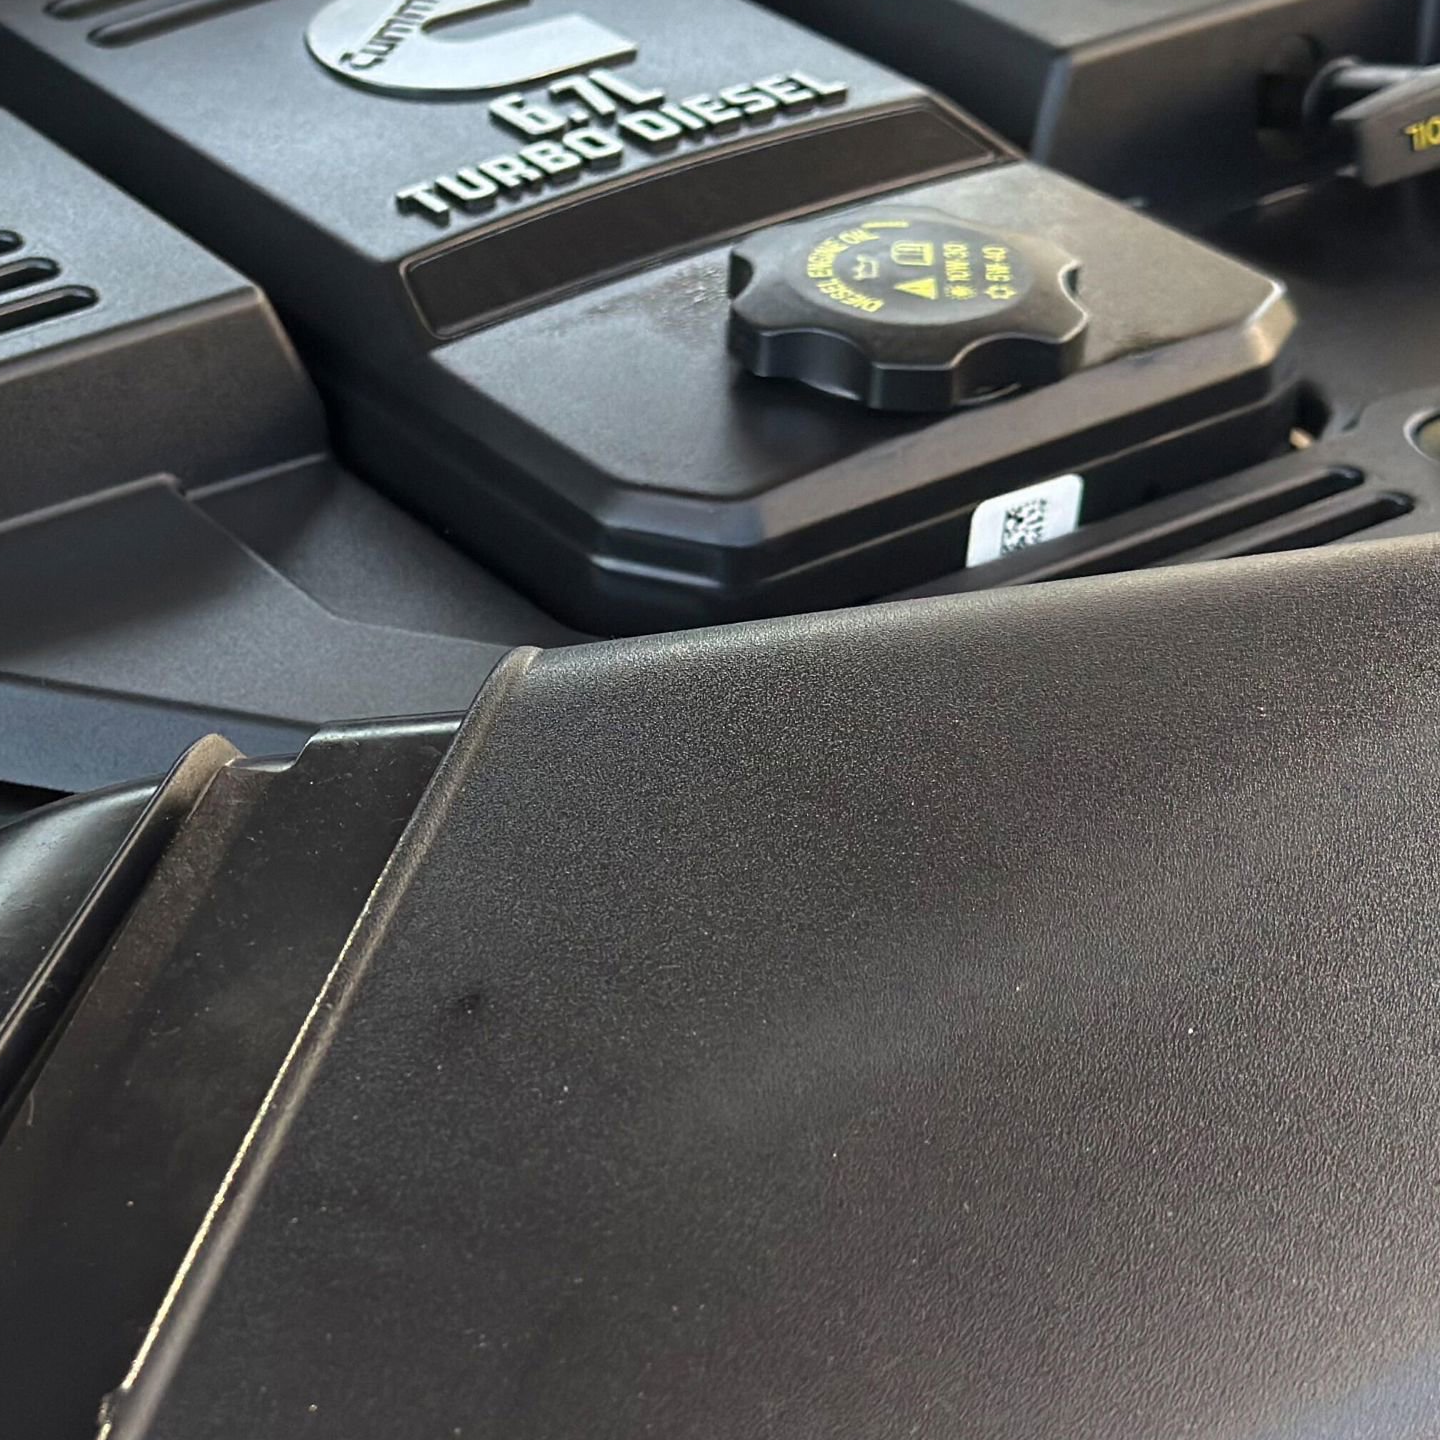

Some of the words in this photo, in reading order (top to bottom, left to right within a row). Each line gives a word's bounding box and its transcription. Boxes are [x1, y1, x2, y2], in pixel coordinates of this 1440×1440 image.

[489, 70, 666, 137] 6.7L
[396, 128, 623, 226] TURBO
[617, 68, 850, 155] DIESEL
[806, 236, 850, 279] ENGINE
[816, 275, 885, 313] DIESEL
